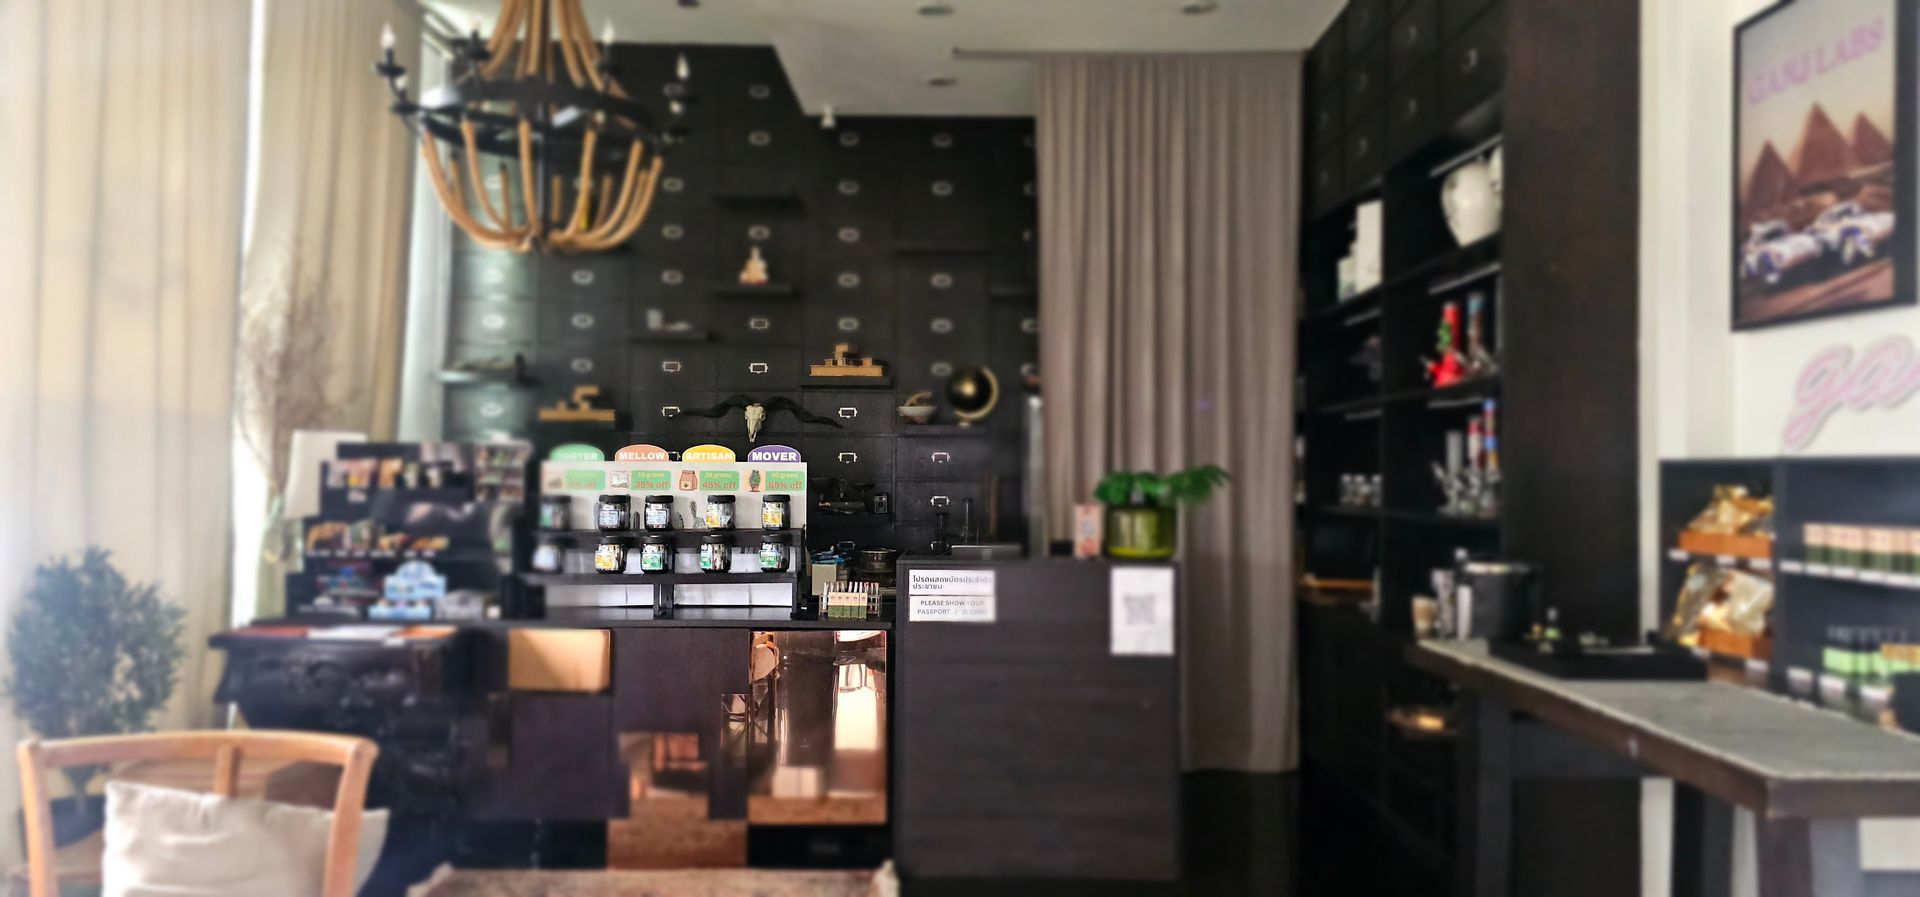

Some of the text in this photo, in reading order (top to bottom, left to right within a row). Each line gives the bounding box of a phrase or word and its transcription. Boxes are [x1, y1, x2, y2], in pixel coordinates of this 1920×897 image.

[1815, 17, 1886, 76] LABS
[556, 452, 598, 460] STER
[619, 452, 665, 460] MELLOW
[686, 452, 733, 460] ARTISAN
[752, 452, 797, 461] MOVER
[635, 481, 669, 489] 35% off
[724, 481, 736, 489] off
[790, 481, 803, 489] off
